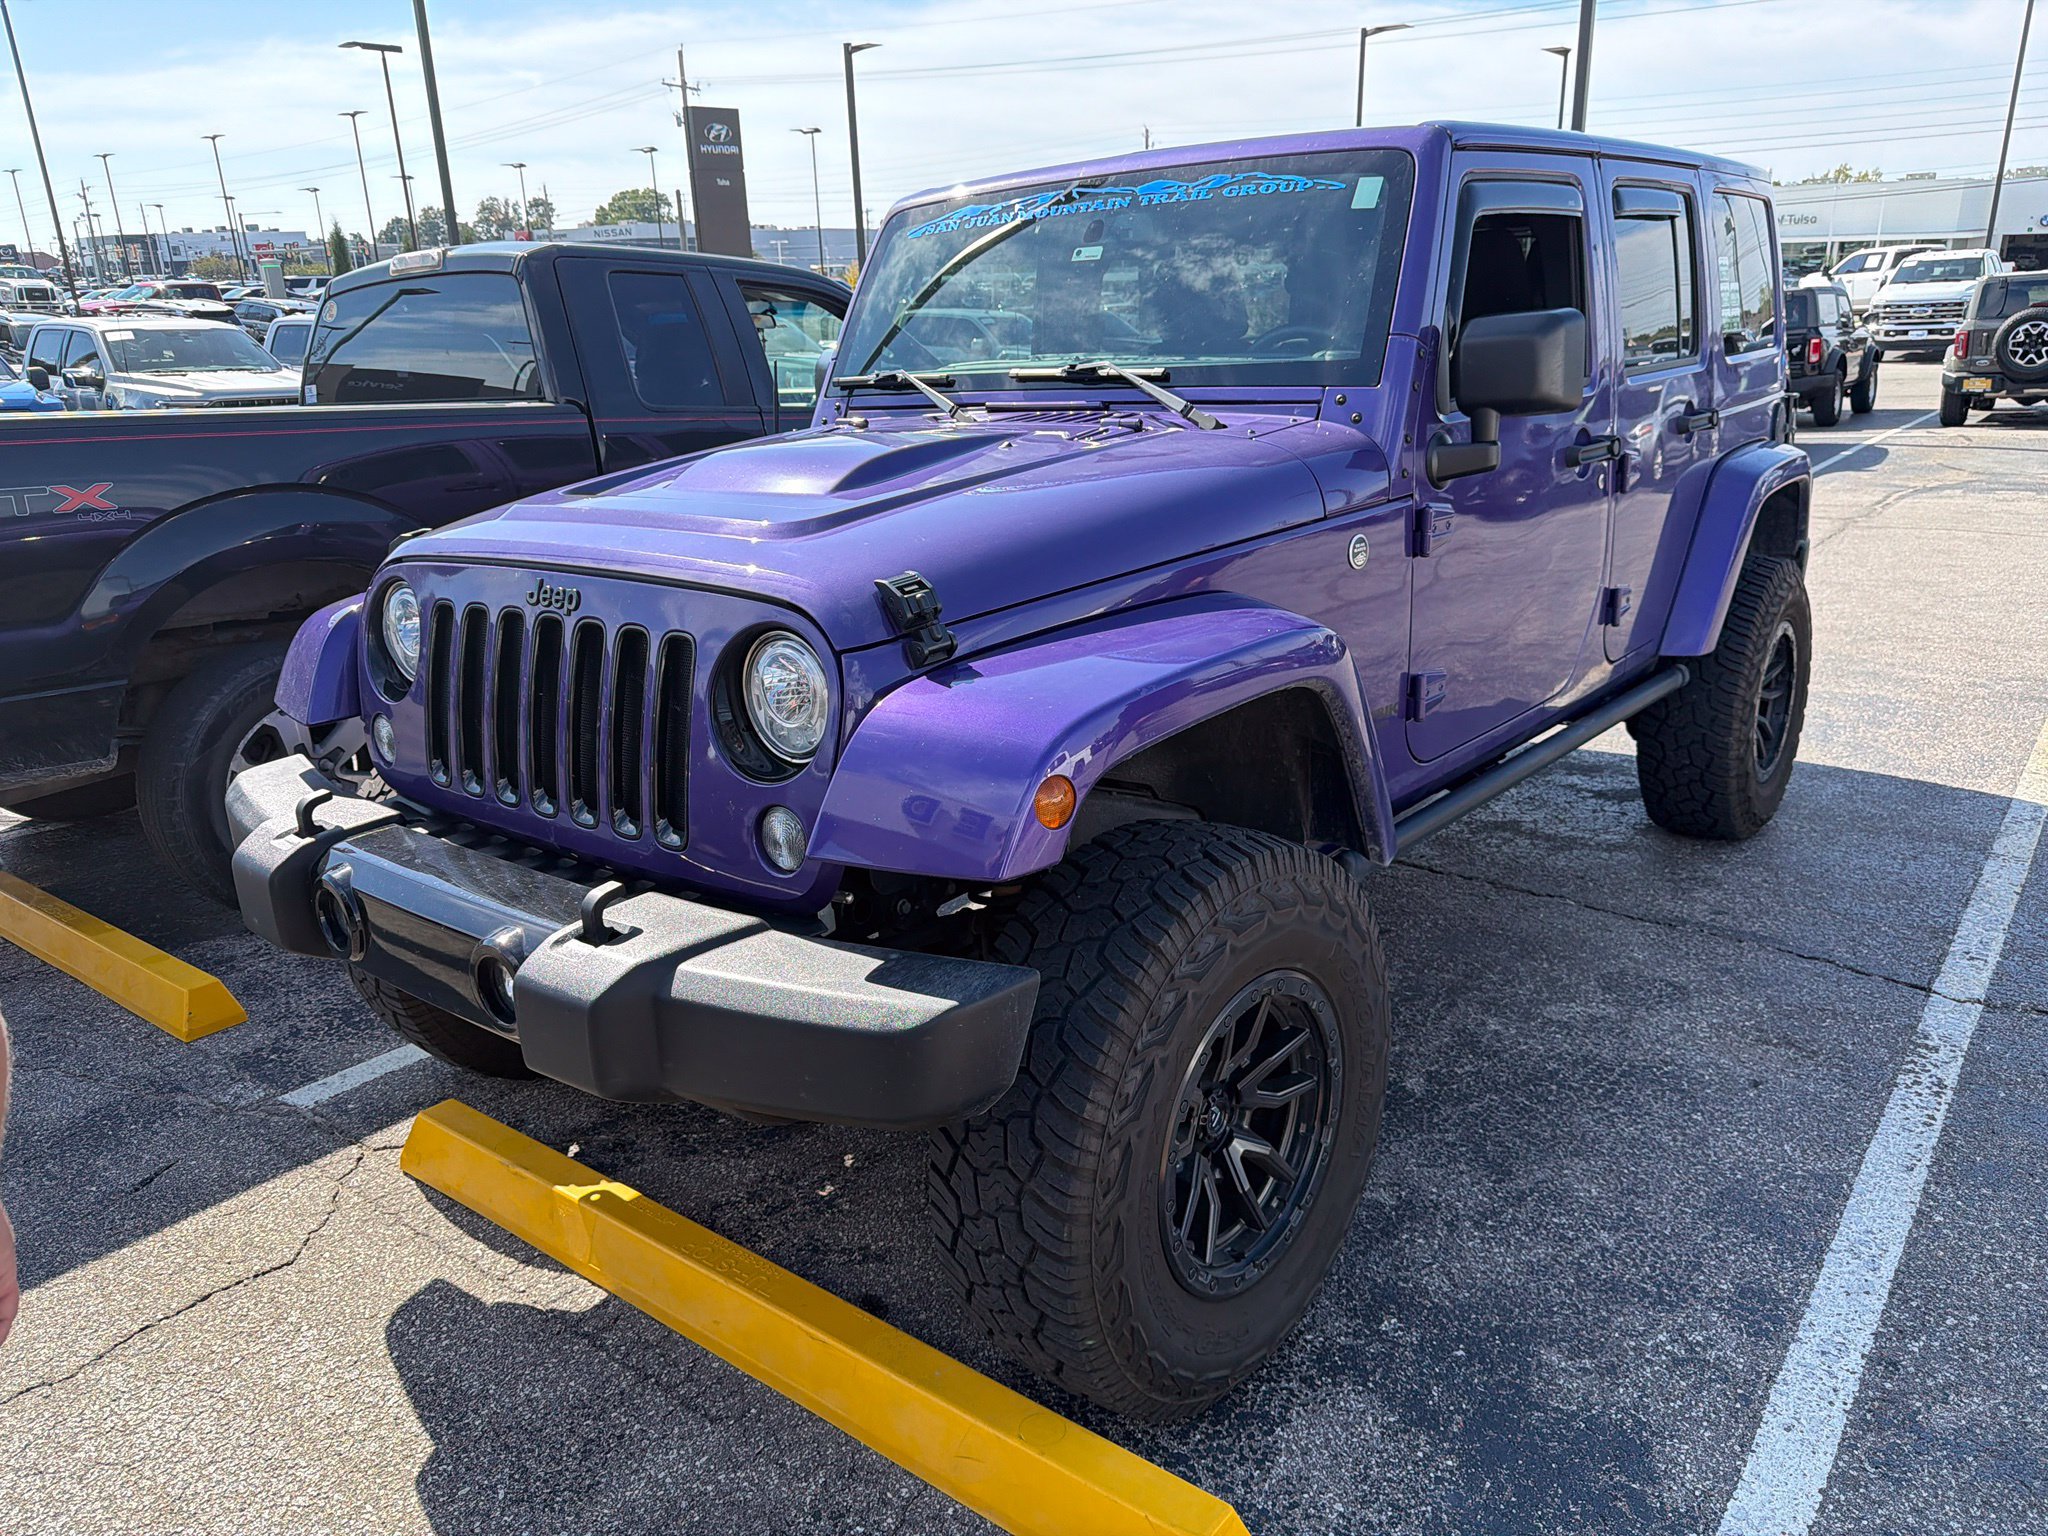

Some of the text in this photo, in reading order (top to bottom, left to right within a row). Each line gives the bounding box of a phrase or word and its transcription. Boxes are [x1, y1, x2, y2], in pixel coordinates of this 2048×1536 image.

[700, 144, 739, 155] HYUNDAI
[925, 179, 1314, 236] SAN JUAN MOUNTAIN TRAIL GROUP
[1787, 213, 1818, 225] Tulsa
[593, 228, 633, 239] NISSAN
[526, 577, 581, 616] Jeep
